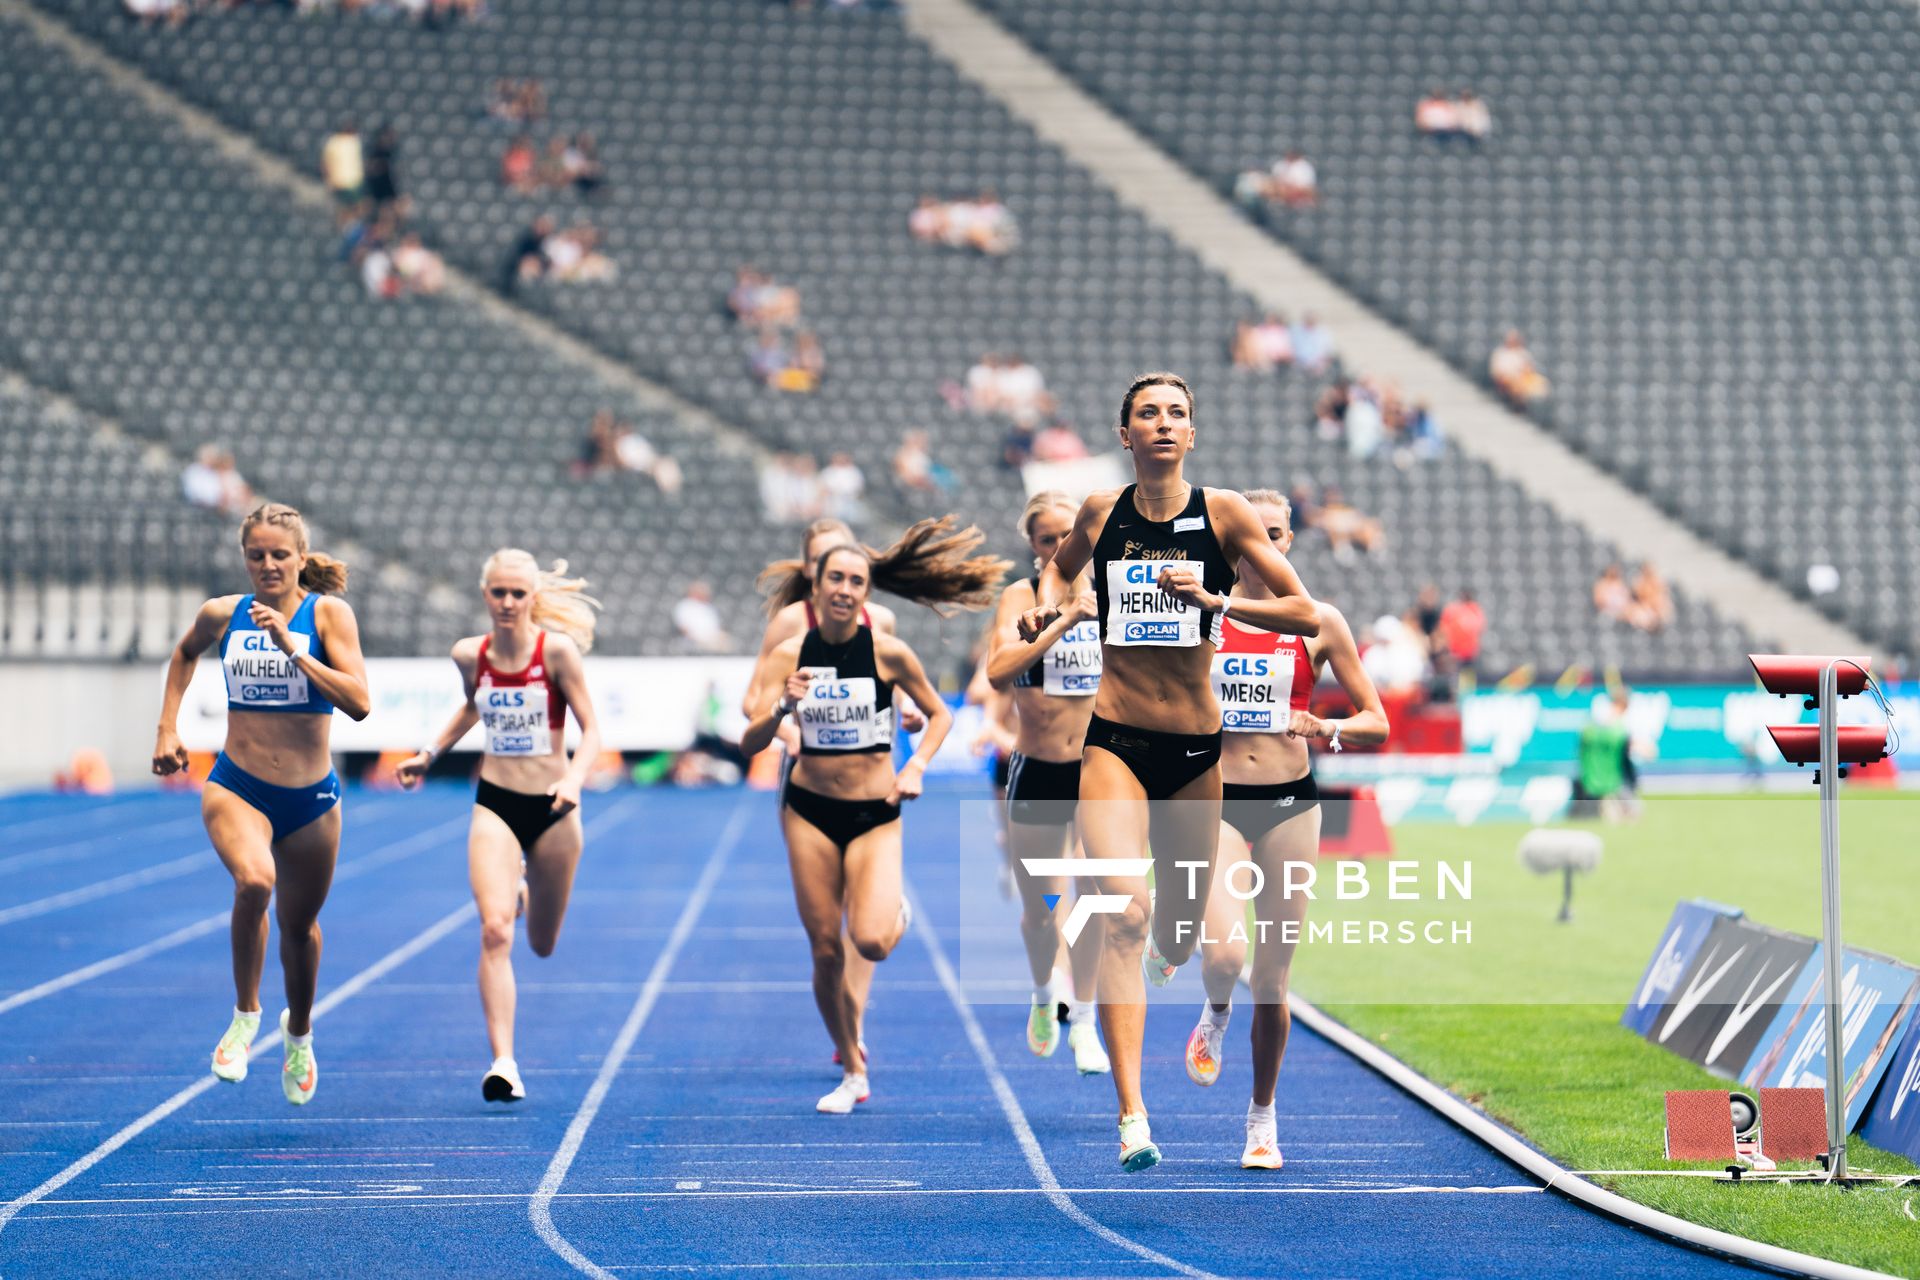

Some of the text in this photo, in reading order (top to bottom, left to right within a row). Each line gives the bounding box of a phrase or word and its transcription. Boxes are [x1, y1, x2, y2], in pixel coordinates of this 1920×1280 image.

[1120, 592, 1187, 614] HERING
[1147, 625, 1178, 635] PLAN
[231, 659, 298, 679] WILHELM
[261, 687, 287, 696] PLAN
[1221, 683, 1276, 703] MEISL
[803, 705, 870, 723] SWELAM
[1242, 712, 1270, 723] PLAN
